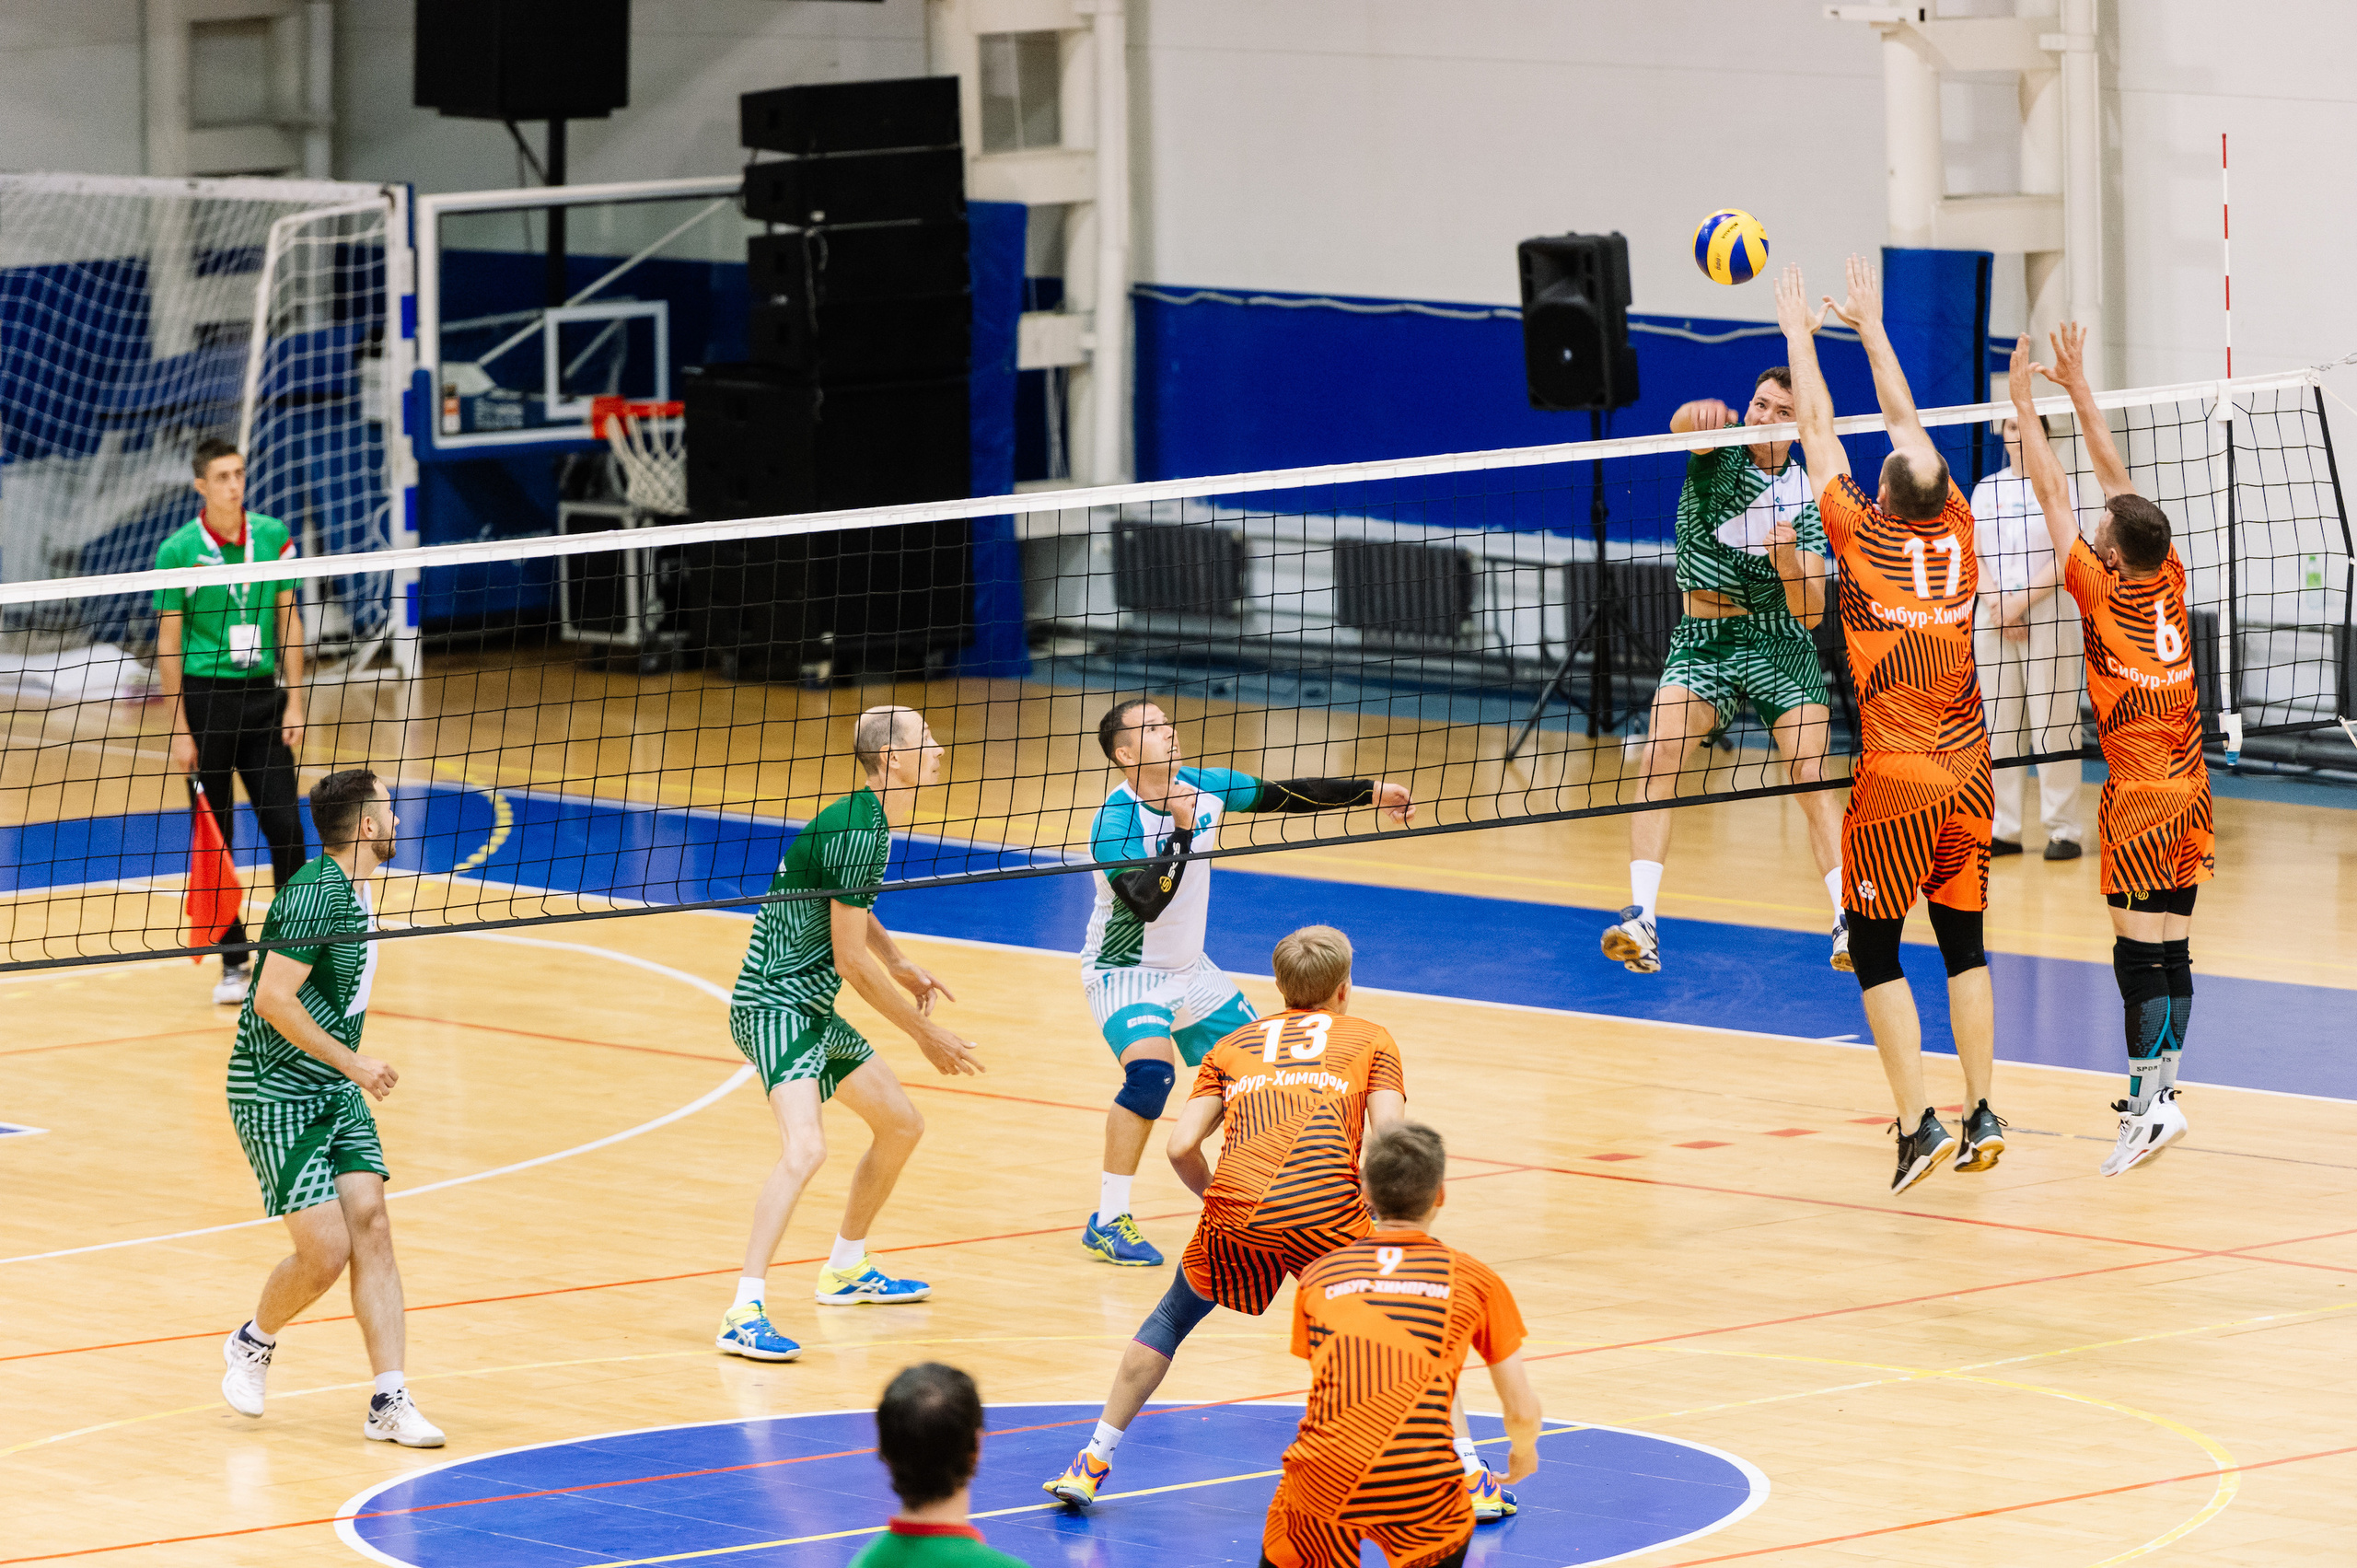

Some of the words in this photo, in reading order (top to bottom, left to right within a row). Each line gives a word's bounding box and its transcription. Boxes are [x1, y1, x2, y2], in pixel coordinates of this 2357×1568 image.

[1903, 534, 1962, 598] 17
[2154, 598, 2183, 662] 6
[2107, 656, 2193, 690] Сибур-Хим
[1259, 1013, 1333, 1063] 13
[1225, 1070, 1350, 1102] Сибур-Химпром
[1376, 1247, 1403, 1276] 9
[1325, 1279, 1451, 1300] СИБУР-ХИМПРОМ
